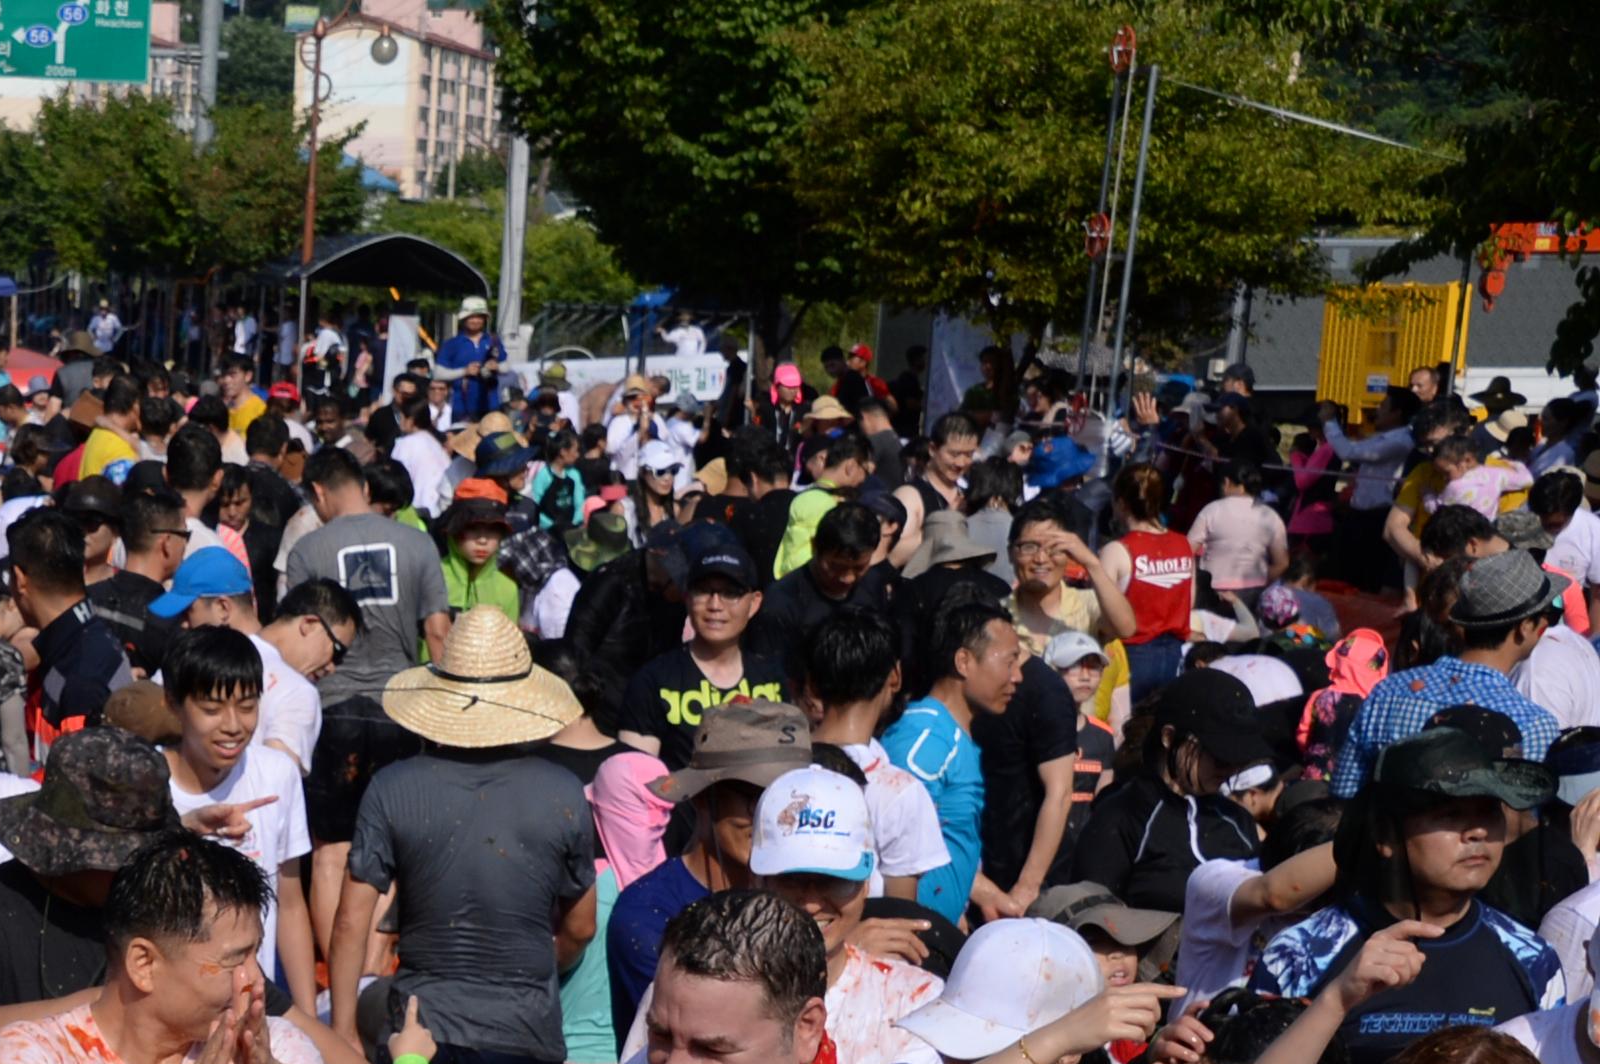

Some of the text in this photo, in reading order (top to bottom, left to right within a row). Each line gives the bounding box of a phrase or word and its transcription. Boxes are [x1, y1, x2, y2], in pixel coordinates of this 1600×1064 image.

[62, 8, 83, 20] 56
[29, 30, 50, 43] 56
[45, 65, 77, 77] 200m
[695, 367, 707, 391] 길
[778, 725, 797, 744] S
